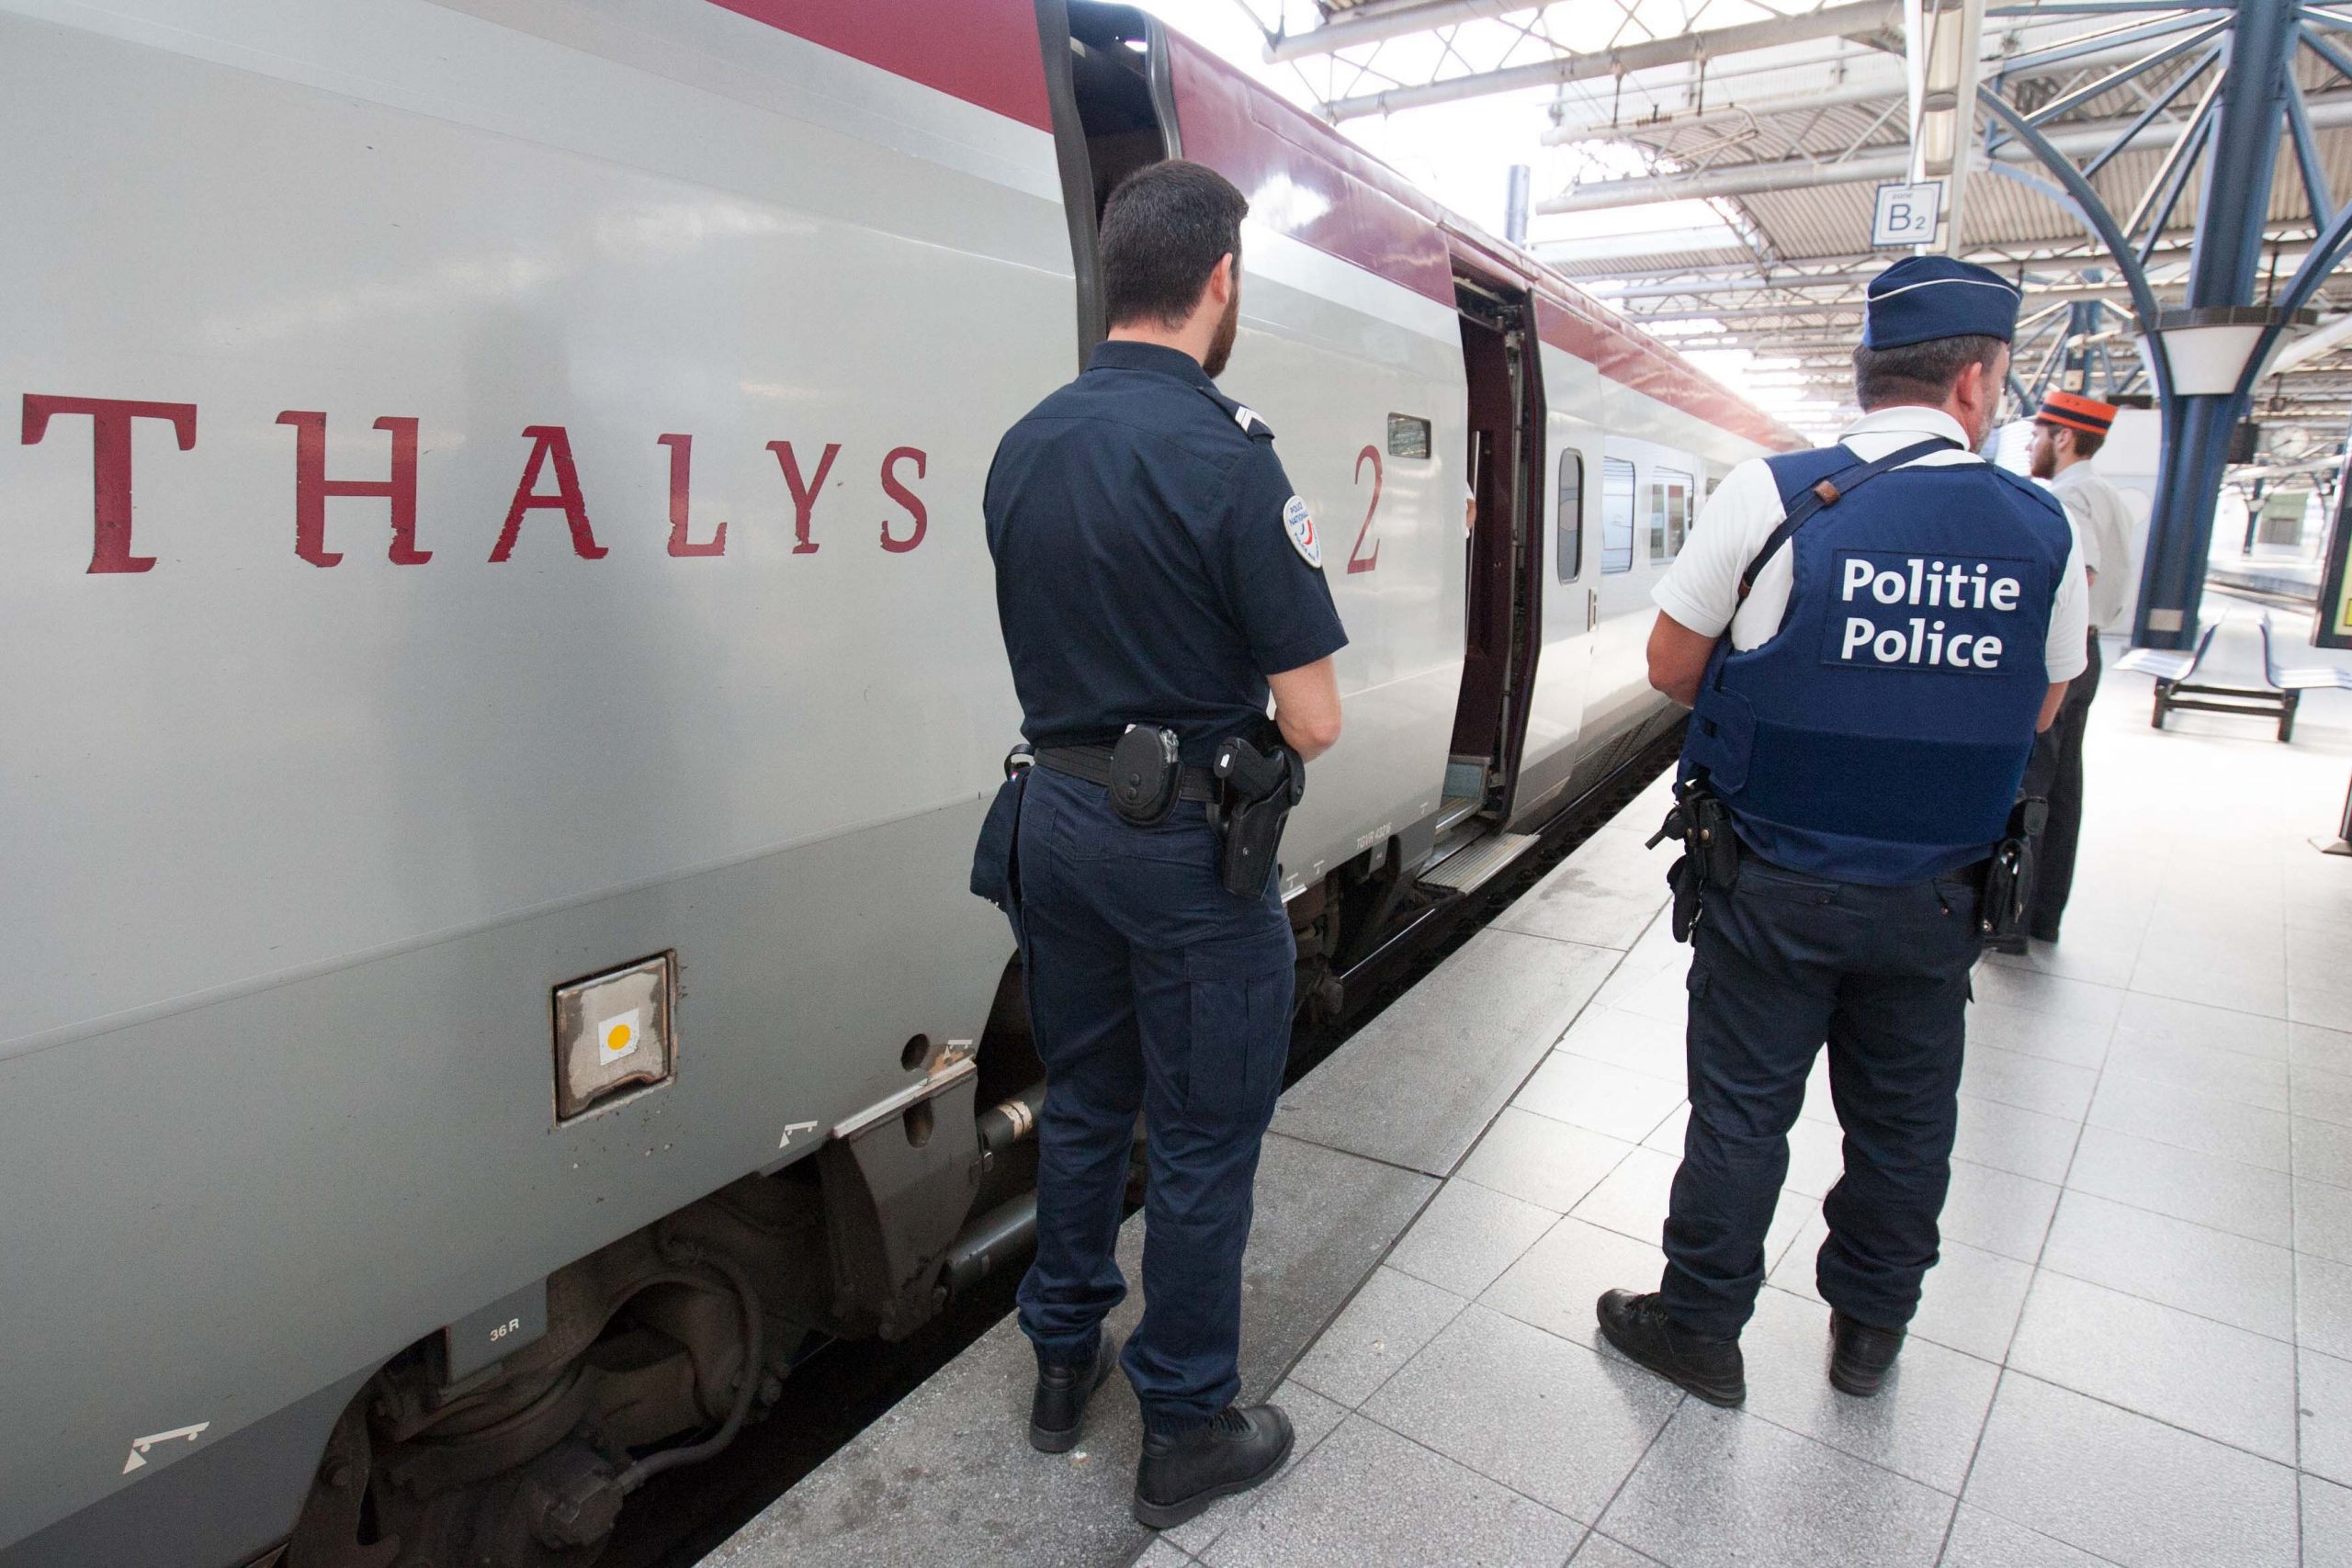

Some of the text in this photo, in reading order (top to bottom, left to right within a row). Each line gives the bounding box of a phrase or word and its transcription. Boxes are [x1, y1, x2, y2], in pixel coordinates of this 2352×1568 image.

[21, 392, 929, 575] THALYS
[1347, 445, 1383, 574] 2
[1842, 558, 2020, 611] Politie
[1841, 617, 2003, 668] Police
